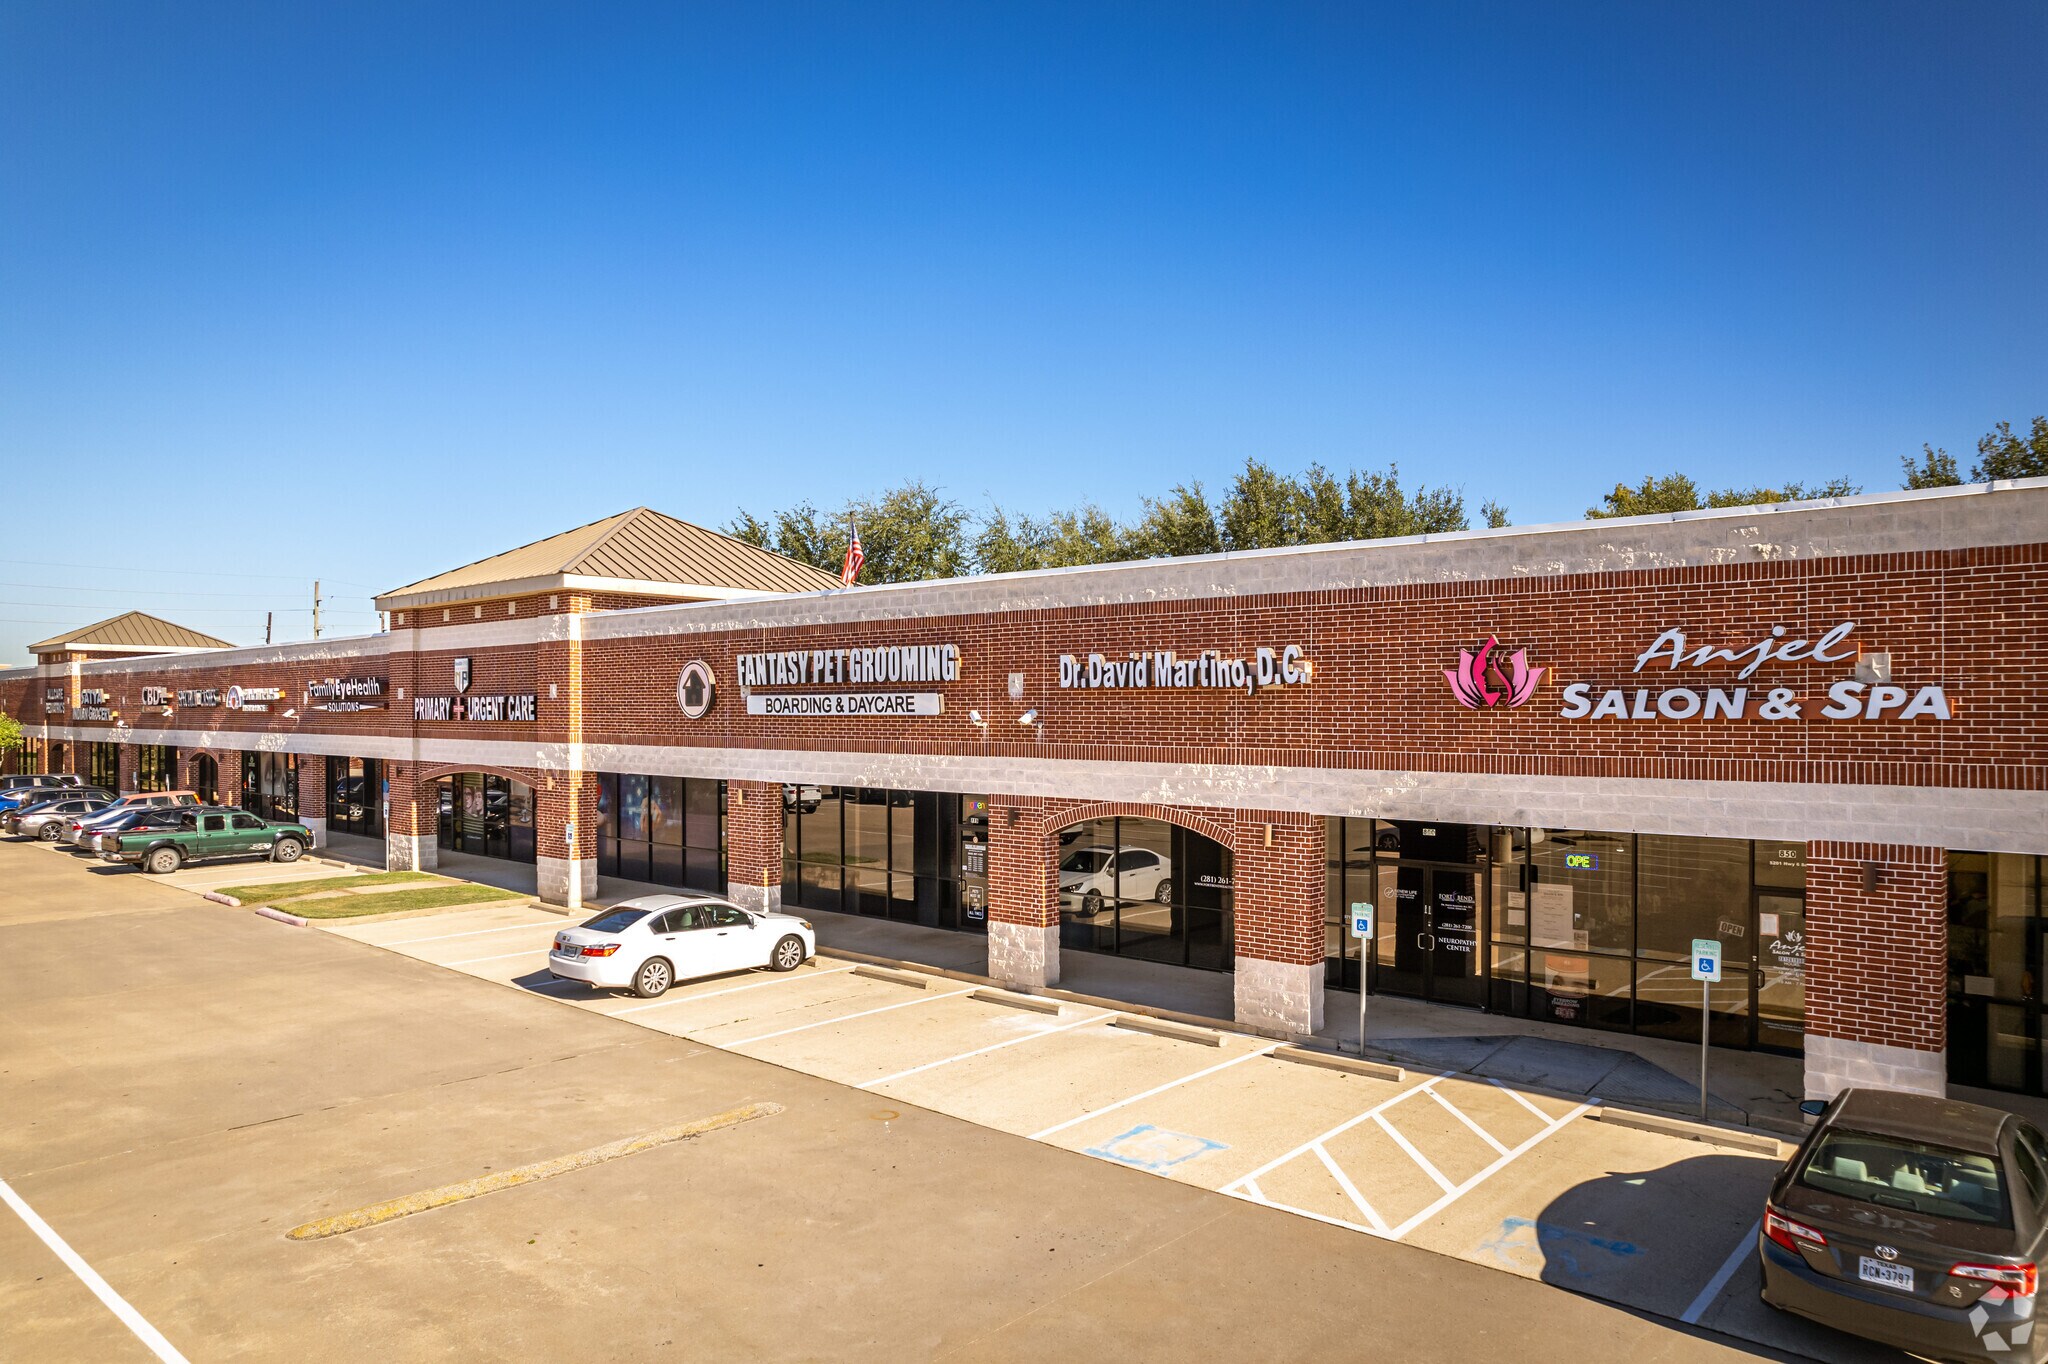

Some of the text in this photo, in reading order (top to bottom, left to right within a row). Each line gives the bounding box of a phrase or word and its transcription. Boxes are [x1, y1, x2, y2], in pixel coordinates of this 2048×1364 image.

[1632, 621, 1858, 681] Anjel
[736, 643, 957, 686] FANTASY PET GROOMING
[1059, 644, 1307, 697] Dr. David Martino, D.C.
[327, 702, 360, 712] SOLUTIONS
[765, 695, 916, 715] BOARDING & DAYCARE
[1559, 680, 1953, 721] SALON & SPA
[414, 695, 535, 721] PRIMARY URGENT CARE
[1779, 850, 1797, 858] 850
[1200, 875, 1216, 883] (281)
[1720, 922, 1743, 935] OPEN
[1438, 936, 1478, 947] NEUROPATHY
[1446, 944, 1471, 953] CENTER
[1876, 1261, 1897, 1270] TEXAS
